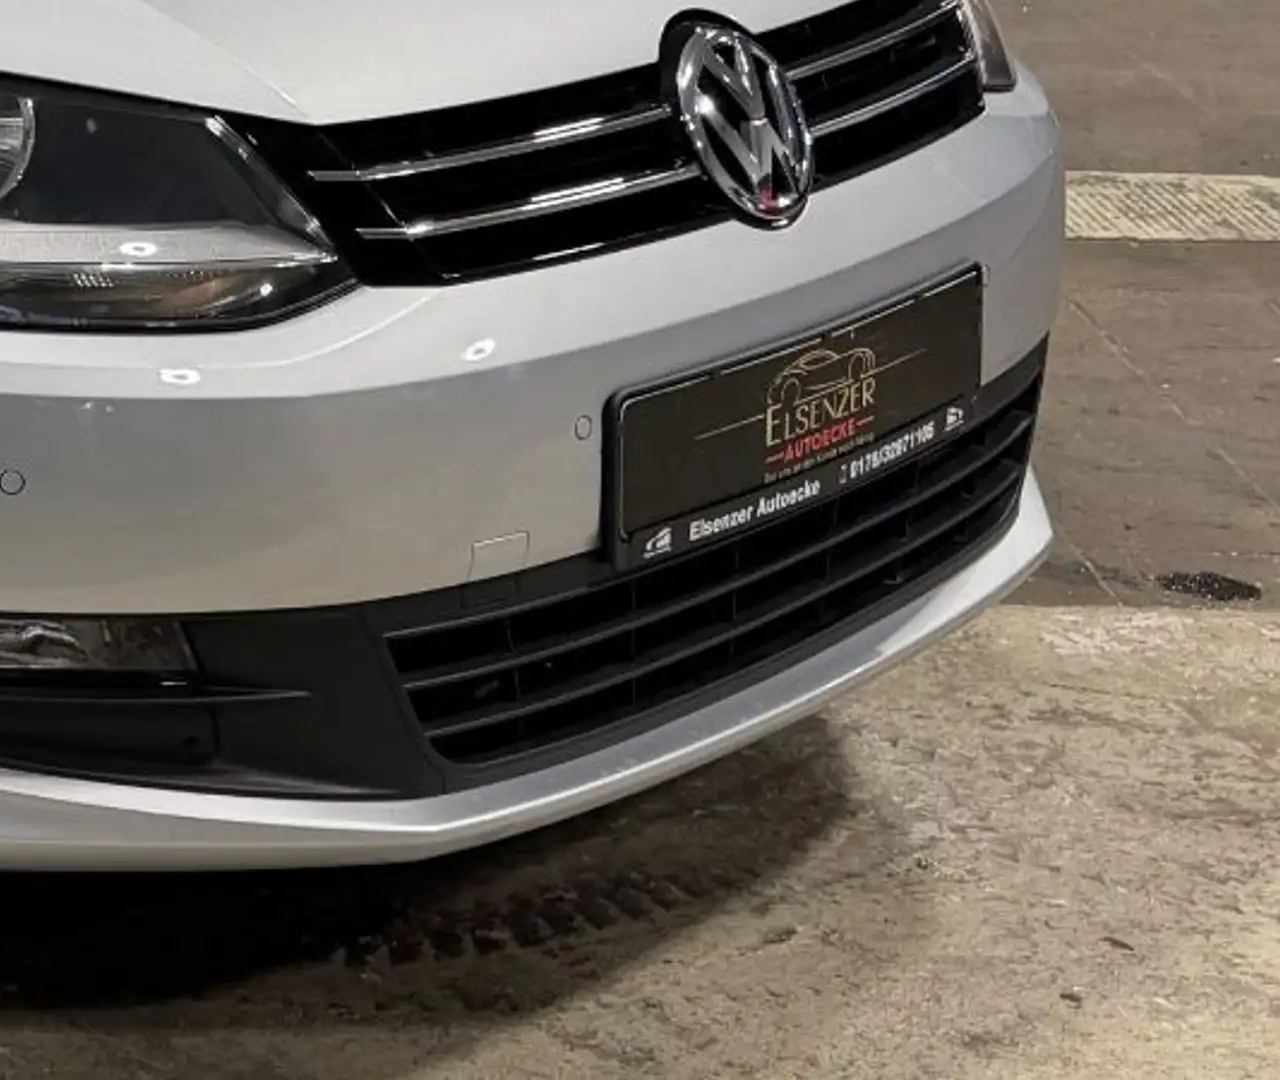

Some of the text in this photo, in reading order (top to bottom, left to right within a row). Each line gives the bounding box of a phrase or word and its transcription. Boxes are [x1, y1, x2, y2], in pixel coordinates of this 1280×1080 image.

[766, 377, 876, 447] ELSENZER
[784, 418, 856, 463] AUTOECKE
[690, 505, 754, 541] Elsenzer
[756, 480, 821, 518] Autoecke
